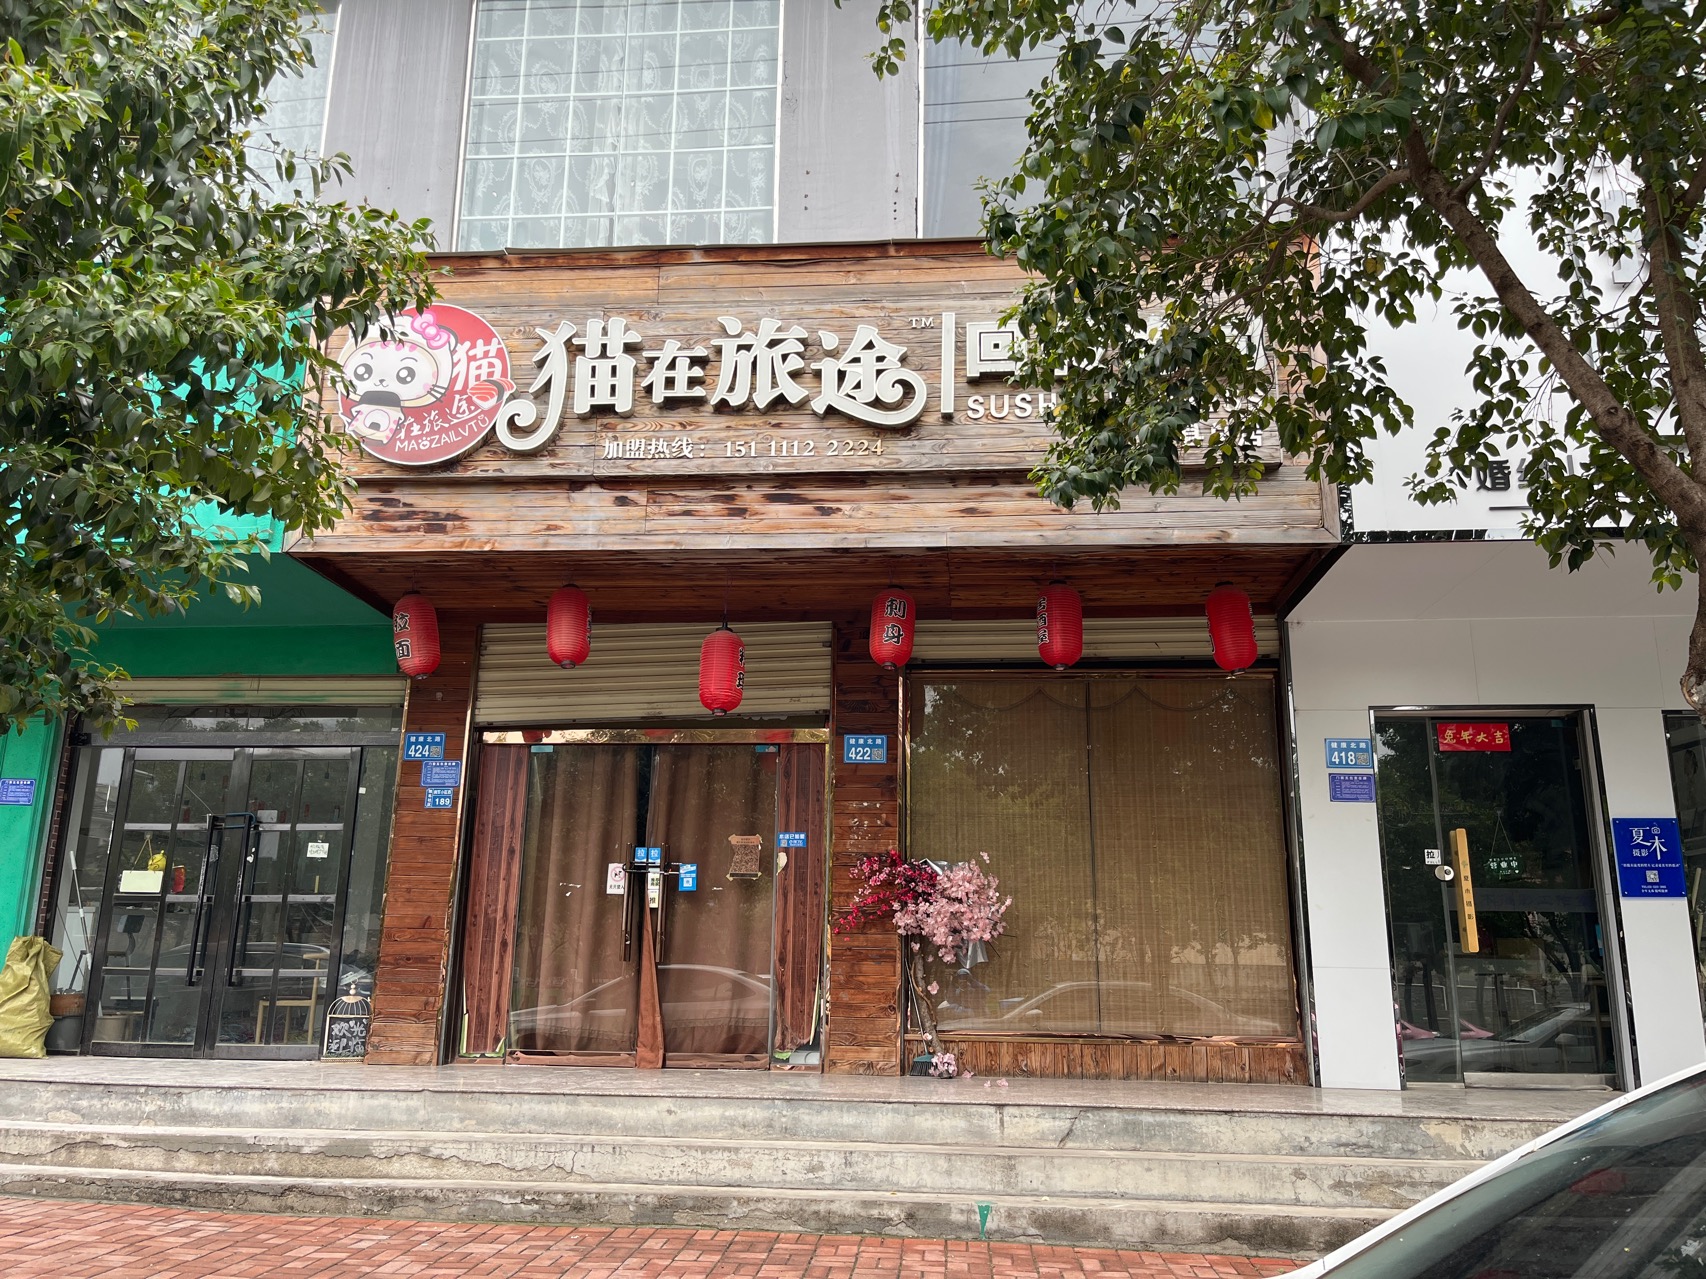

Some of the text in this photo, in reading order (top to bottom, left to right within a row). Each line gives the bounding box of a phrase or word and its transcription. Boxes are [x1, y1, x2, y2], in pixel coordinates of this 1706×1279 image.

[451, 337, 503, 392] 猫
[498, 315, 927, 454] 猫在旅途
[909, 317, 935, 329] TM
[966, 392, 1060, 420] SUSH
[723, 440, 758, 458] 151
[767, 439, 816, 457] 1112
[826, 438, 884, 456] 2224
[1443, 729, 1504, 744] 兔年大吉
[408, 744, 430, 758] 424
[848, 747, 871, 760] 422
[1331, 751, 1356, 765] 418
[435, 797, 450, 806] 189
[1629, 826, 1668, 860] 夏木
[1426, 850, 1436, 859] 拉
[1632, 848, 1649, 857] 摄影
